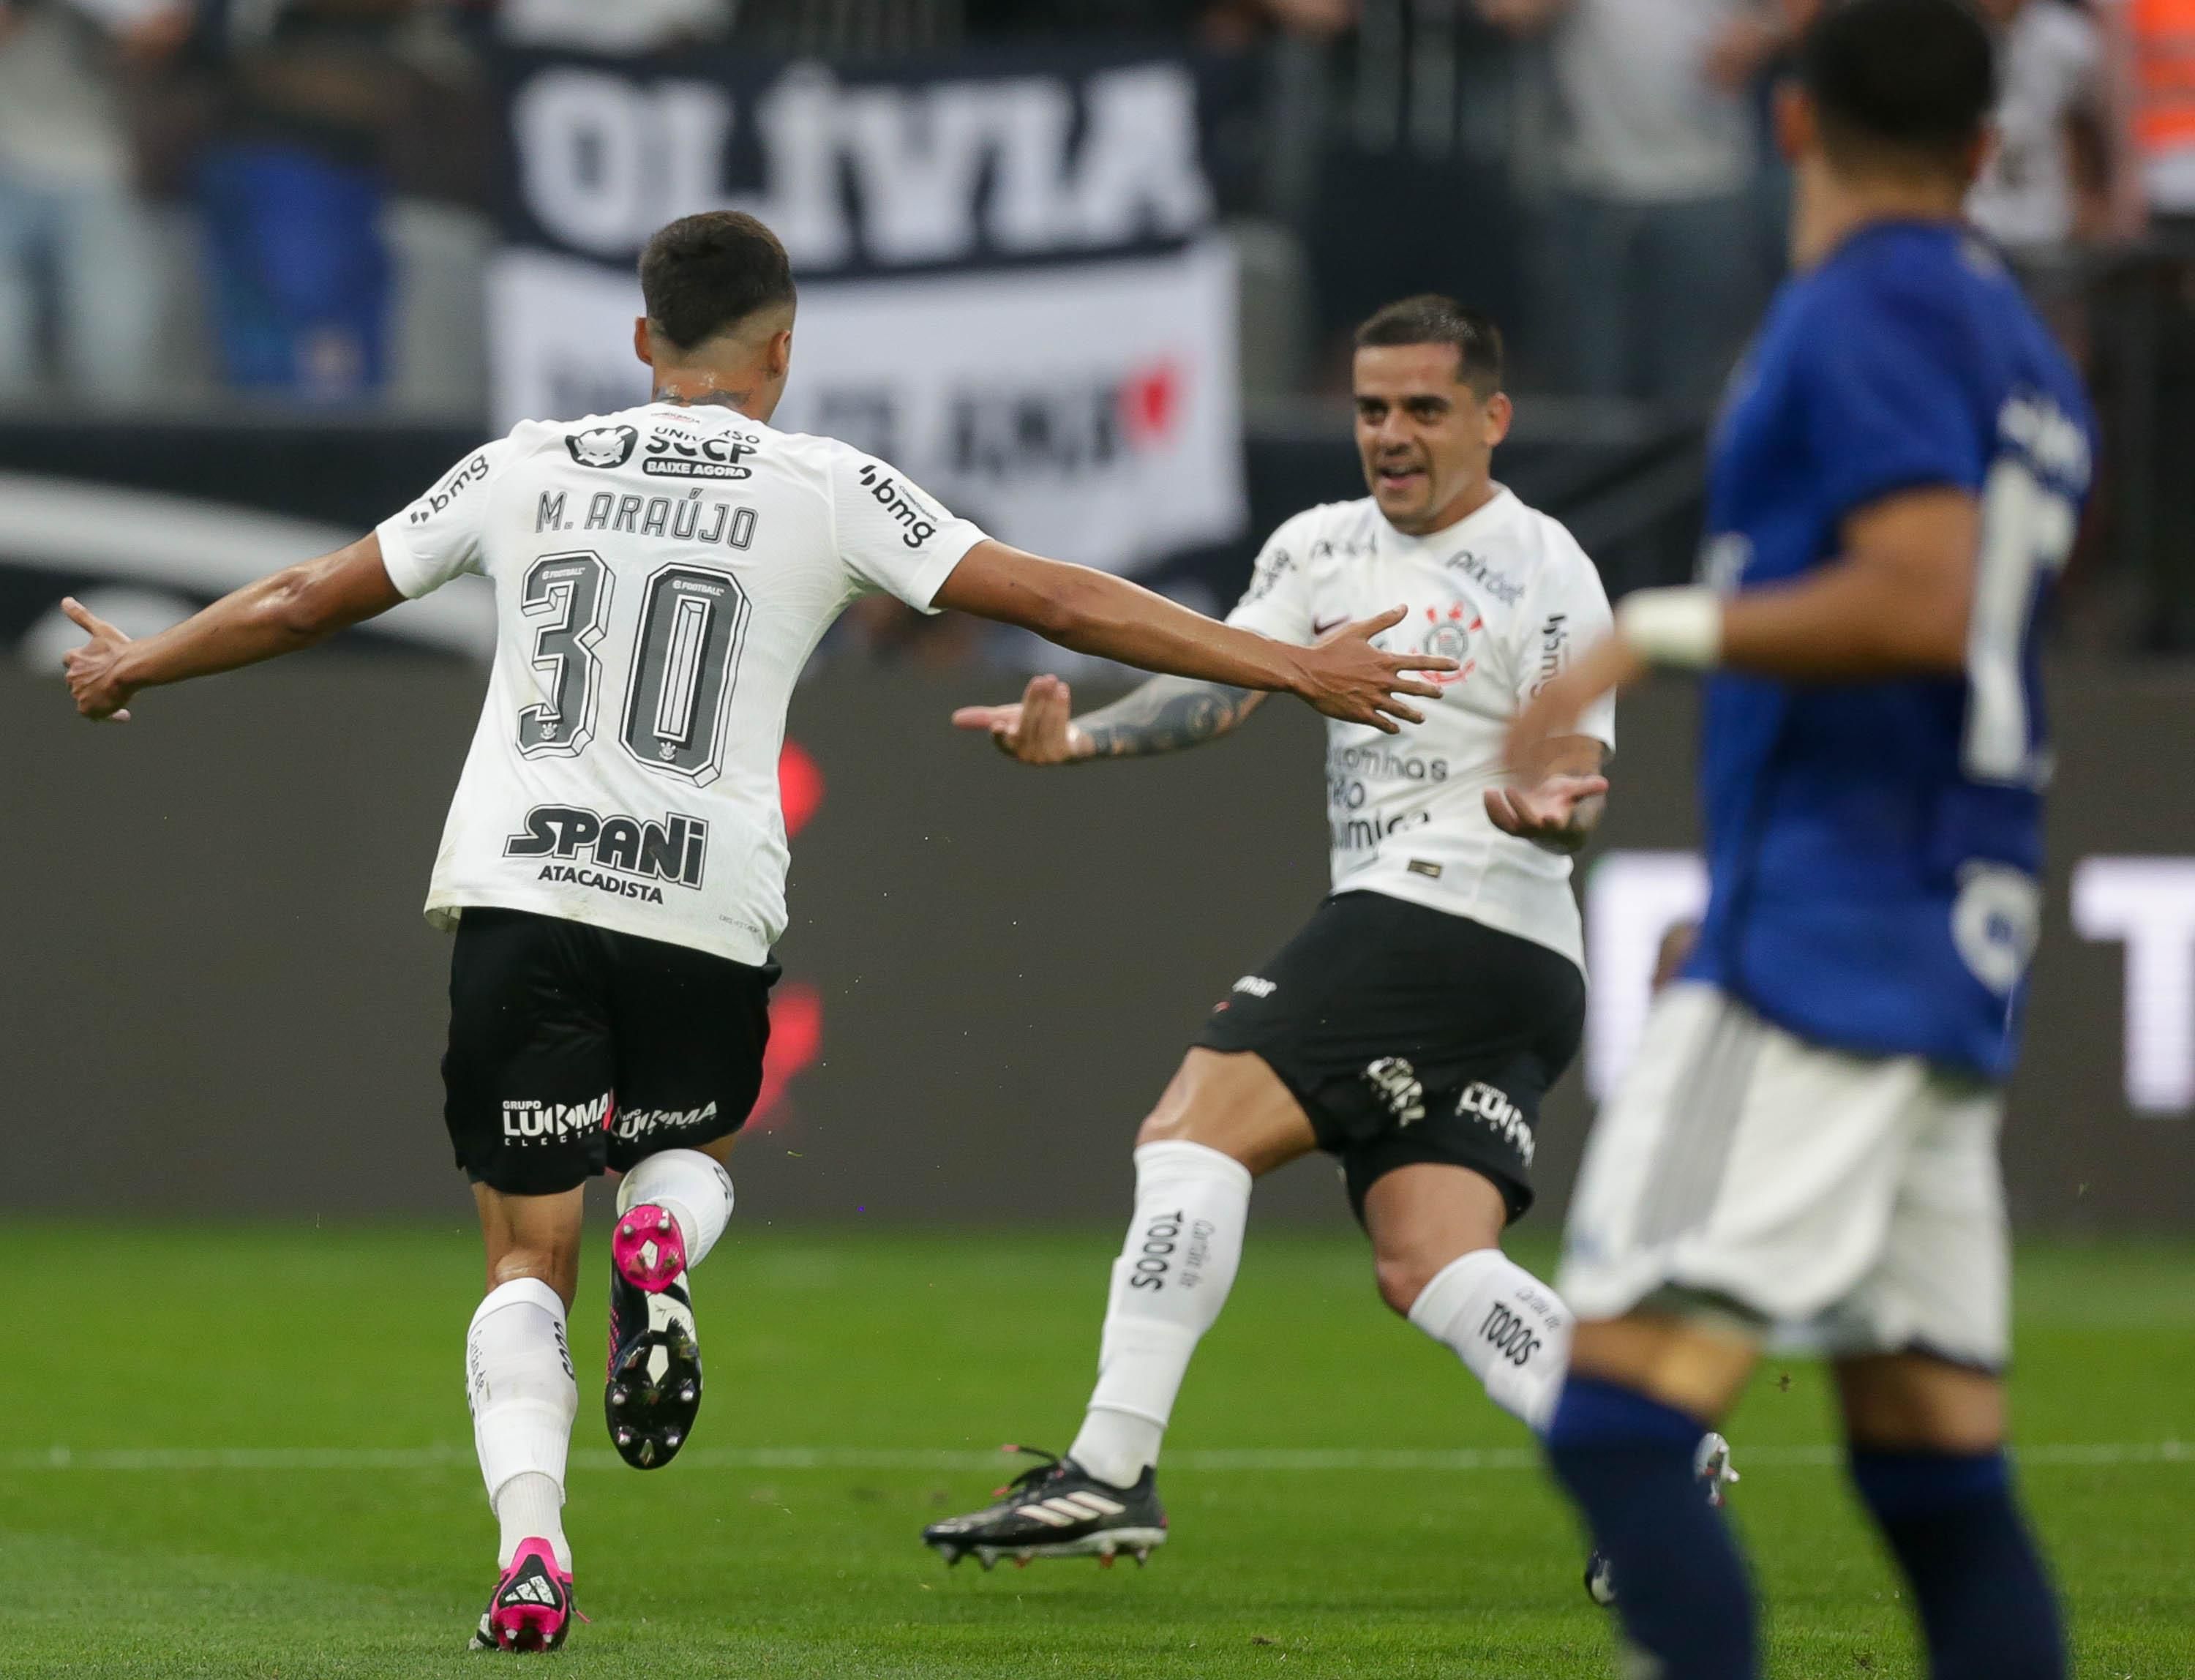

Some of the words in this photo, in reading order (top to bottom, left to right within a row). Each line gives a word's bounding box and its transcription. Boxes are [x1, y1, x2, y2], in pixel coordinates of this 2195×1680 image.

[654, 426, 760, 444] UNIVSO
[429, 453, 489, 514] bmg
[646, 461, 691, 475] BAIXE
[693, 464, 747, 478] AGORA
[535, 490, 574, 533] M.
[583, 487, 759, 552] ARAÚJO
[871, 477, 937, 549] bmg
[515, 550, 753, 789] 30
[538, 865, 664, 905] ATACADISTA
[502, 1100, 542, 1111] GRUPO
[503, 1092, 609, 1136] LUKMA
[1130, 1210, 1182, 1291] TODOS
[1479, 1302, 1541, 1366] TODOS
